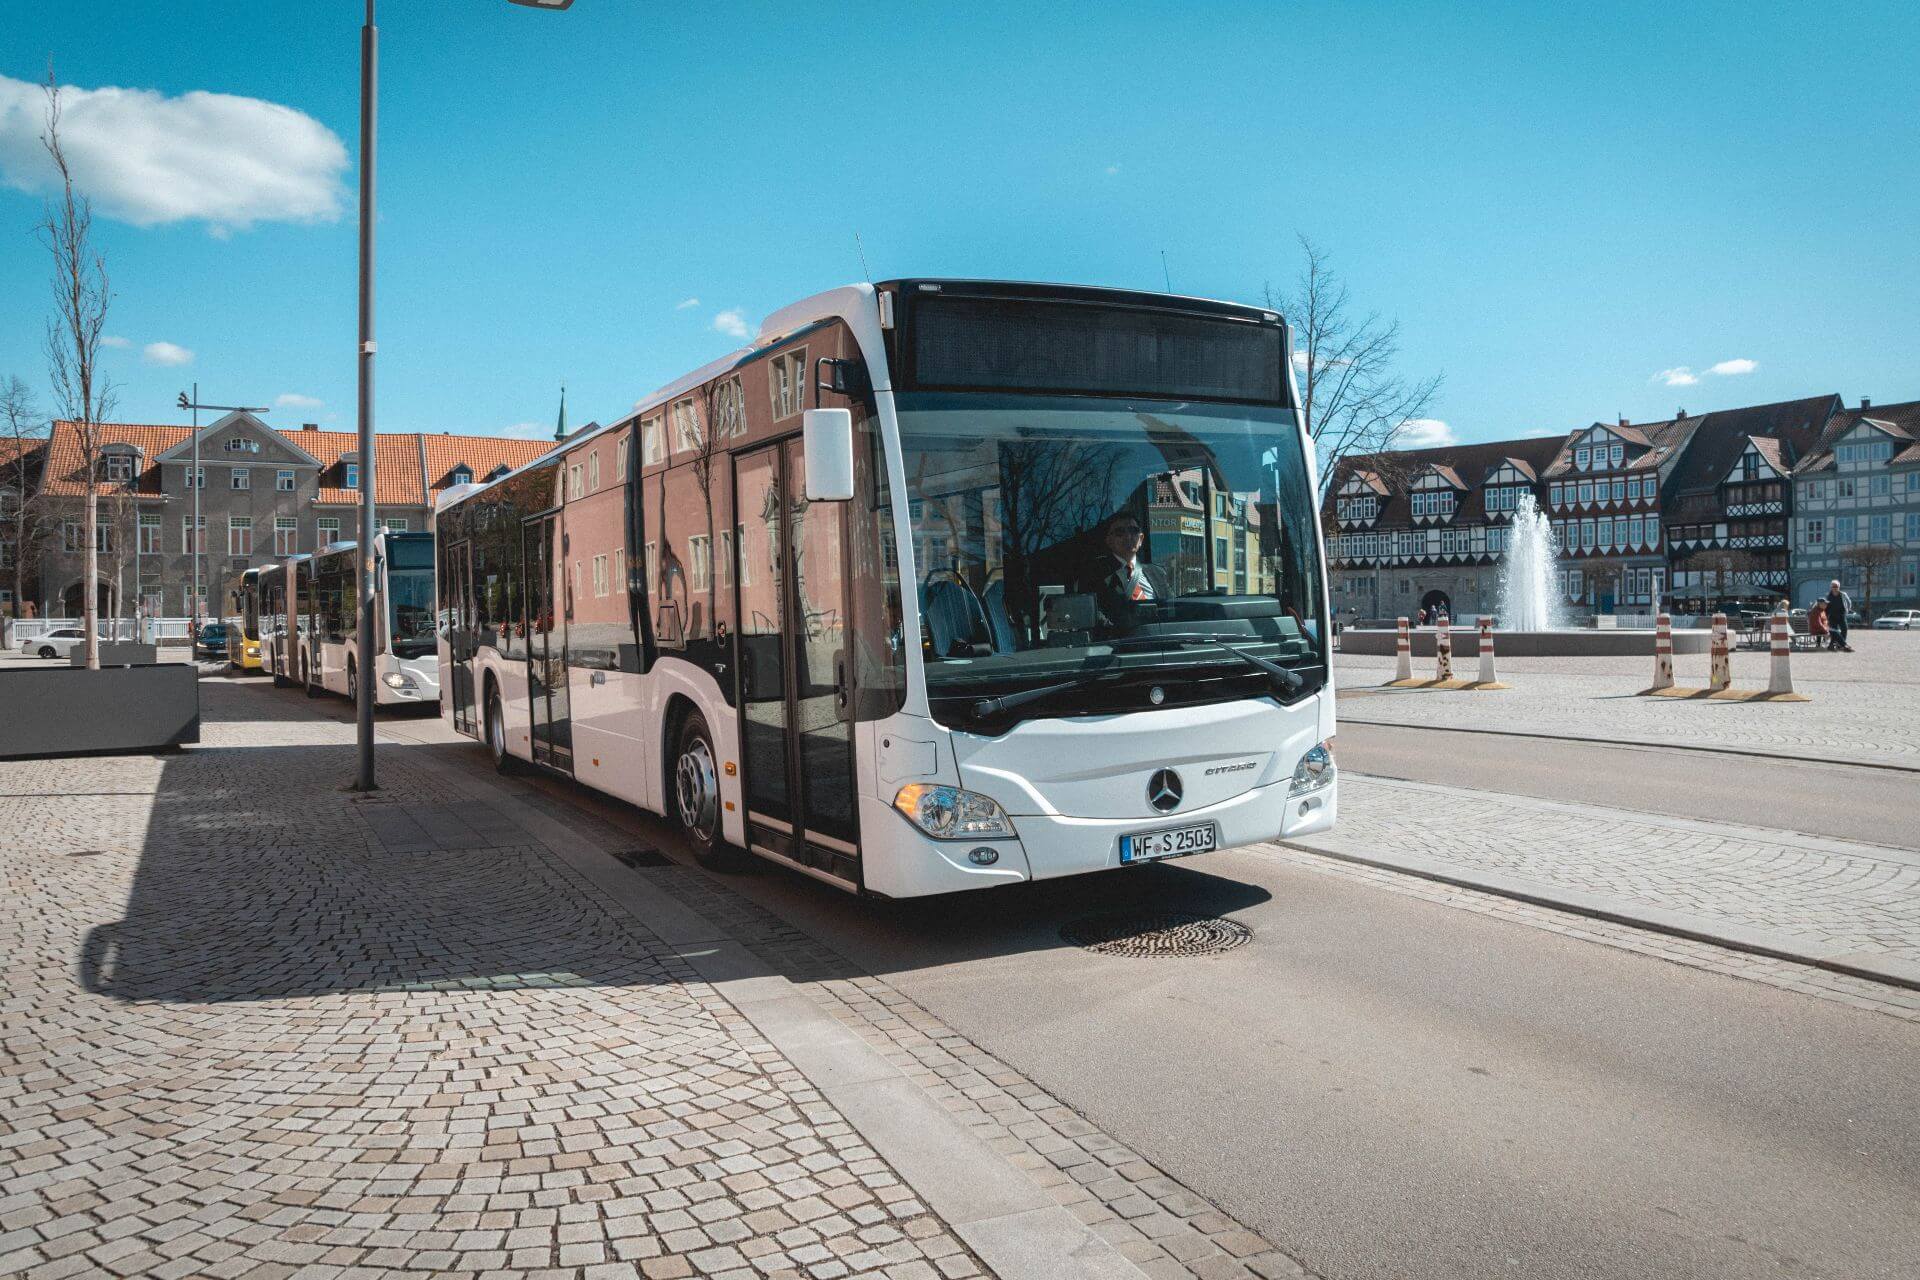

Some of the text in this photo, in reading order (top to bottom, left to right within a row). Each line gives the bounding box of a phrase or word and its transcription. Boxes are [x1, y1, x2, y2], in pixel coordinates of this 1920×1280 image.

[1132, 827, 1213, 857] WF S 2503
